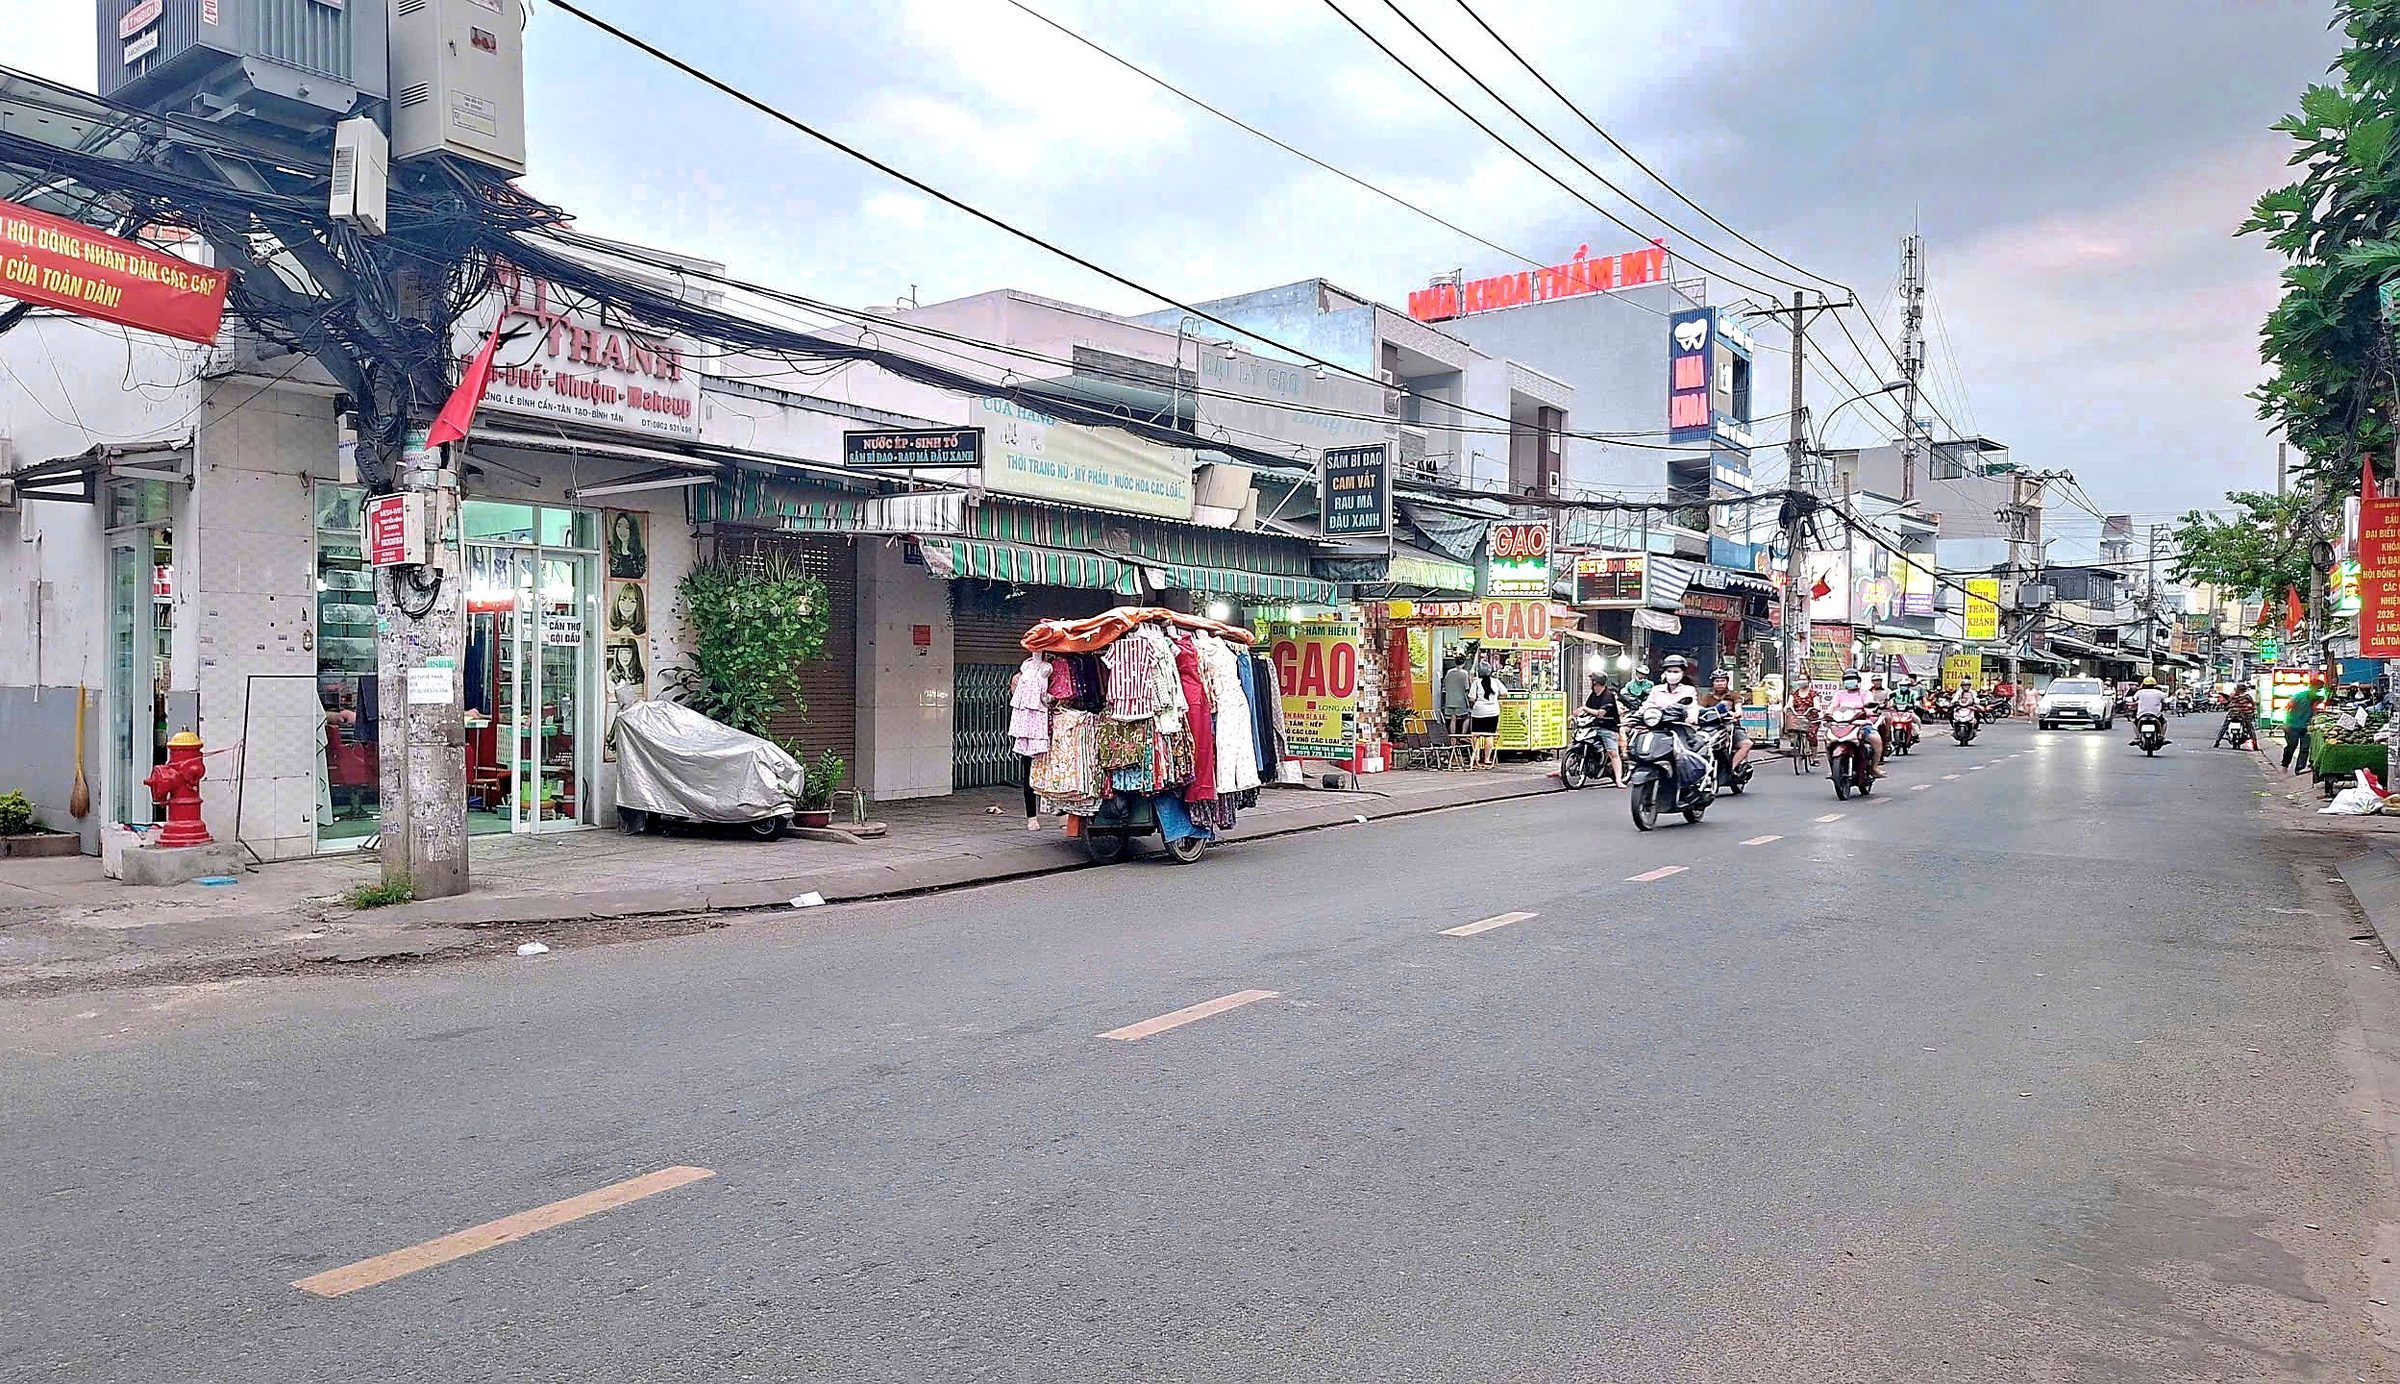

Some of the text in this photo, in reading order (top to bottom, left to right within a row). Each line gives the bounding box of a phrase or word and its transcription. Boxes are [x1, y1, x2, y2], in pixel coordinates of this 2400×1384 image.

[84, 242, 126, 273] NHÂN
[129, 255, 158, 283] DÂN
[160, 265, 189, 290] CÁC
[6, 254, 122, 309] CỦA TOÀN DÂN!
[1408, 237, 1666, 322] NHA KHOA THẨM MỸ
[547, 316, 684, 381] THANH
[626, 386, 692, 420] Makeup
[863, 433, 959, 450] NƯỚC ÉP SINH TỐ
[849, 450, 866, 464] SÂM
[898, 451, 915, 462] RAU
[916, 448, 929, 462] MÁ
[949, 450, 974, 462] XANH
[1326, 452, 1349, 470] SÂM
[1350, 450, 1361, 468] BÍ
[1028, 458, 1056, 477] TRANG
[1135, 478, 1150, 494] HOA
[1151, 479, 1165, 496] CÁC
[1332, 475, 1355, 491] CAM
[1334, 492, 1373, 511] RAU MÁ
[1329, 512, 1380, 532] ĐẬU XANH
[1494, 525, 1548, 562] GẠO
[2365, 529, 2378, 540] ĐẠI
[2382, 581, 2398, 592] CÁC
[1485, 601, 1547, 648] GẠO
[550, 632, 563, 644] GỘI
[2371, 634, 2385, 646] CỦA
[1272, 640, 1356, 711] GẠO
[1318, 704, 1340, 712] LONG
